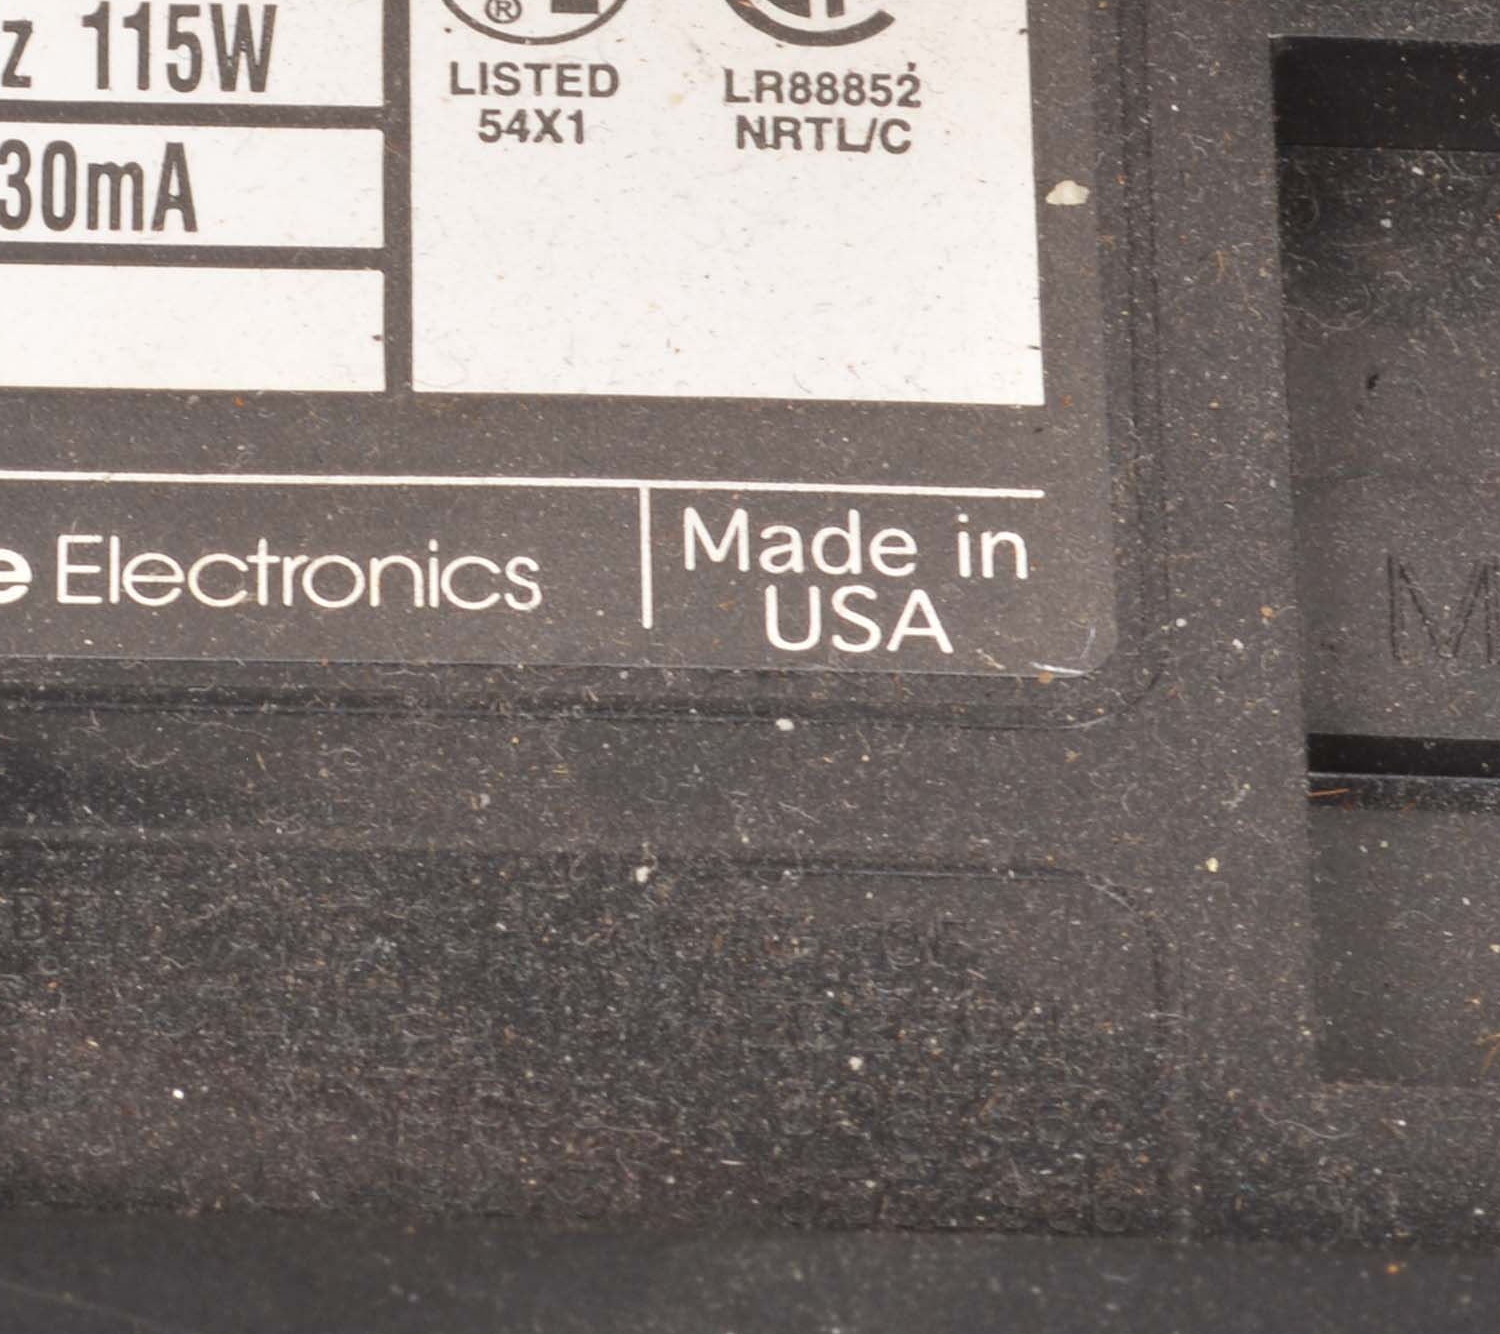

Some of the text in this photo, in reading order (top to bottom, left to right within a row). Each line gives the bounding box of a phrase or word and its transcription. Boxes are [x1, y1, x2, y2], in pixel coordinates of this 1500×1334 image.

[81, 0, 279, 93] 115W
[449, 61, 620, 99] LISTED
[723, 66, 922, 108] LR88852
[478, 108, 586, 145] 54X1
[736, 115, 913, 155] NRTL/C
[683, 506, 1049, 580] Made in
[56, 534, 543, 611] Electronics
[764, 584, 955, 654] USA
